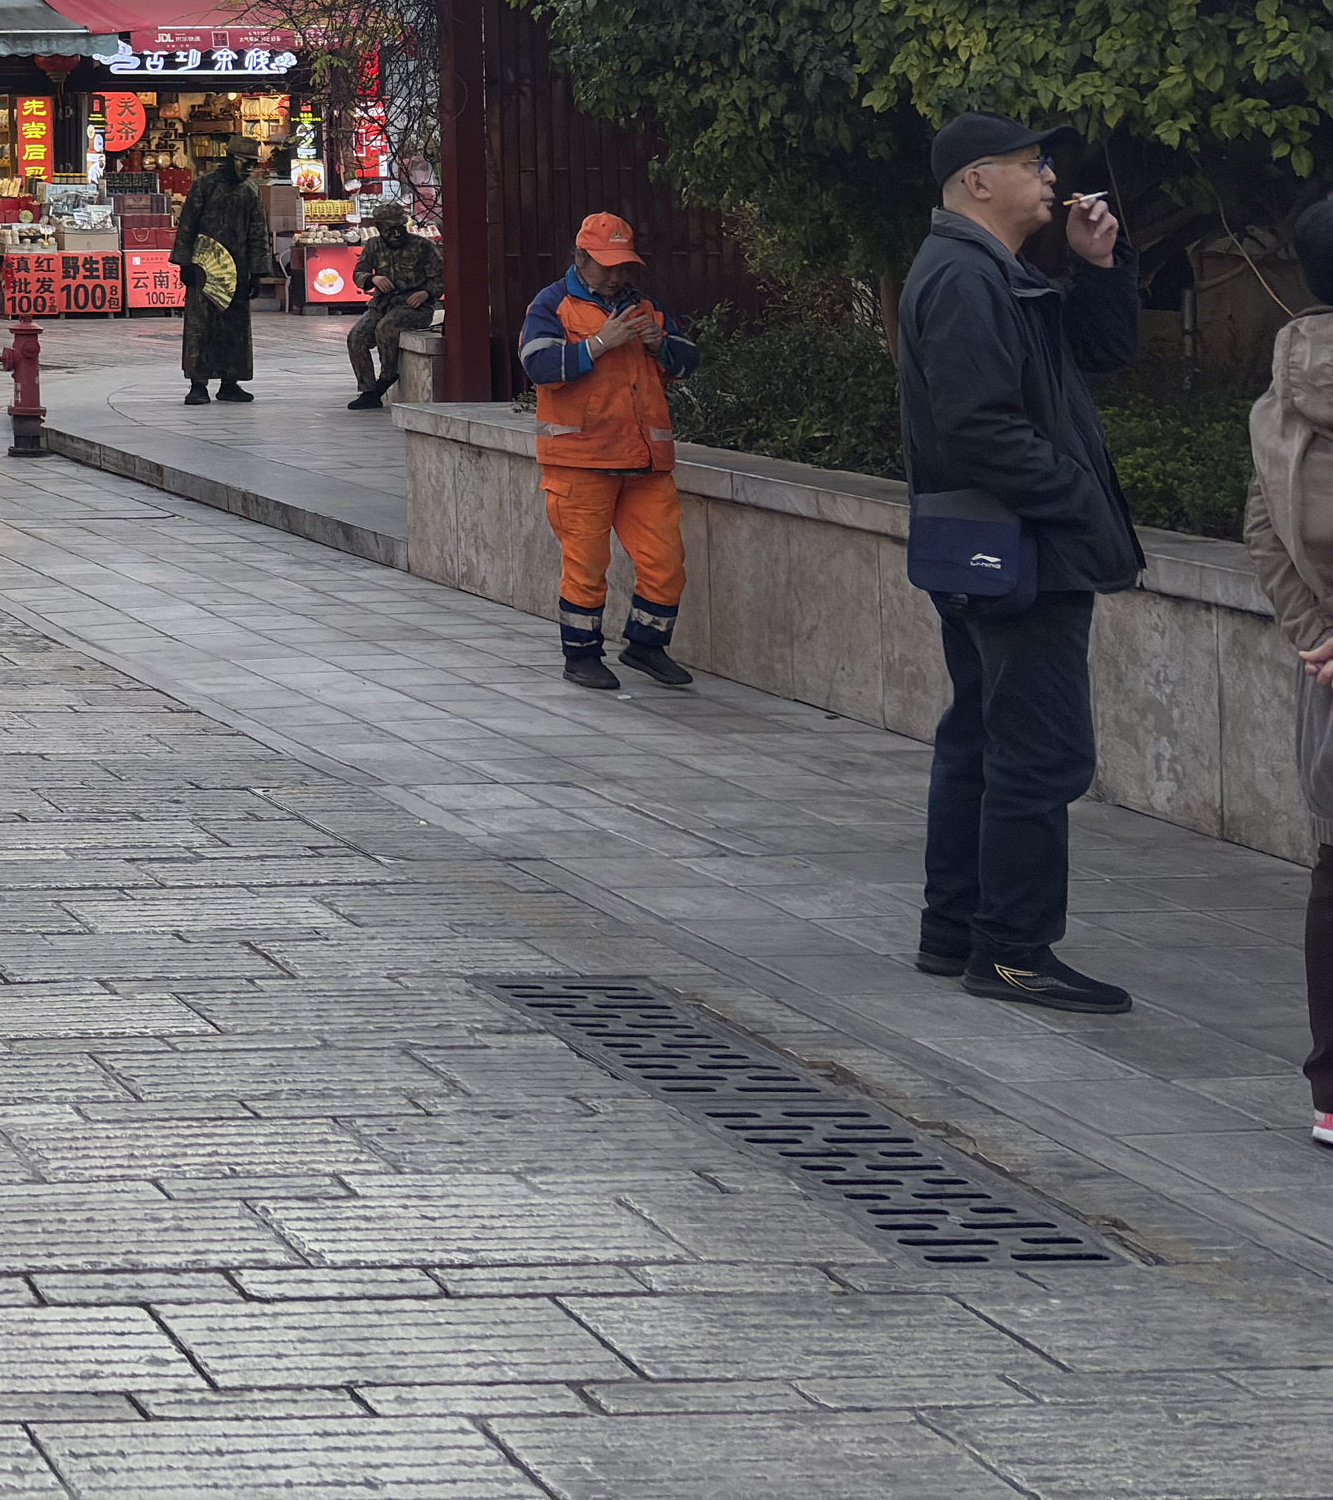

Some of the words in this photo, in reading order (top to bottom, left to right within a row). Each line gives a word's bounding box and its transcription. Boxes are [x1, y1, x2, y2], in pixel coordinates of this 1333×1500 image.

[155, 33, 174, 43] JDL
[21, 99, 48, 180] 先尝后买
[61, 256, 120, 281] 野生菌
[11, 277, 55, 294] 批发
[7, 295, 47, 314] 100
[60, 284, 106, 310] 100
[145, 291, 186, 305] 100元/
